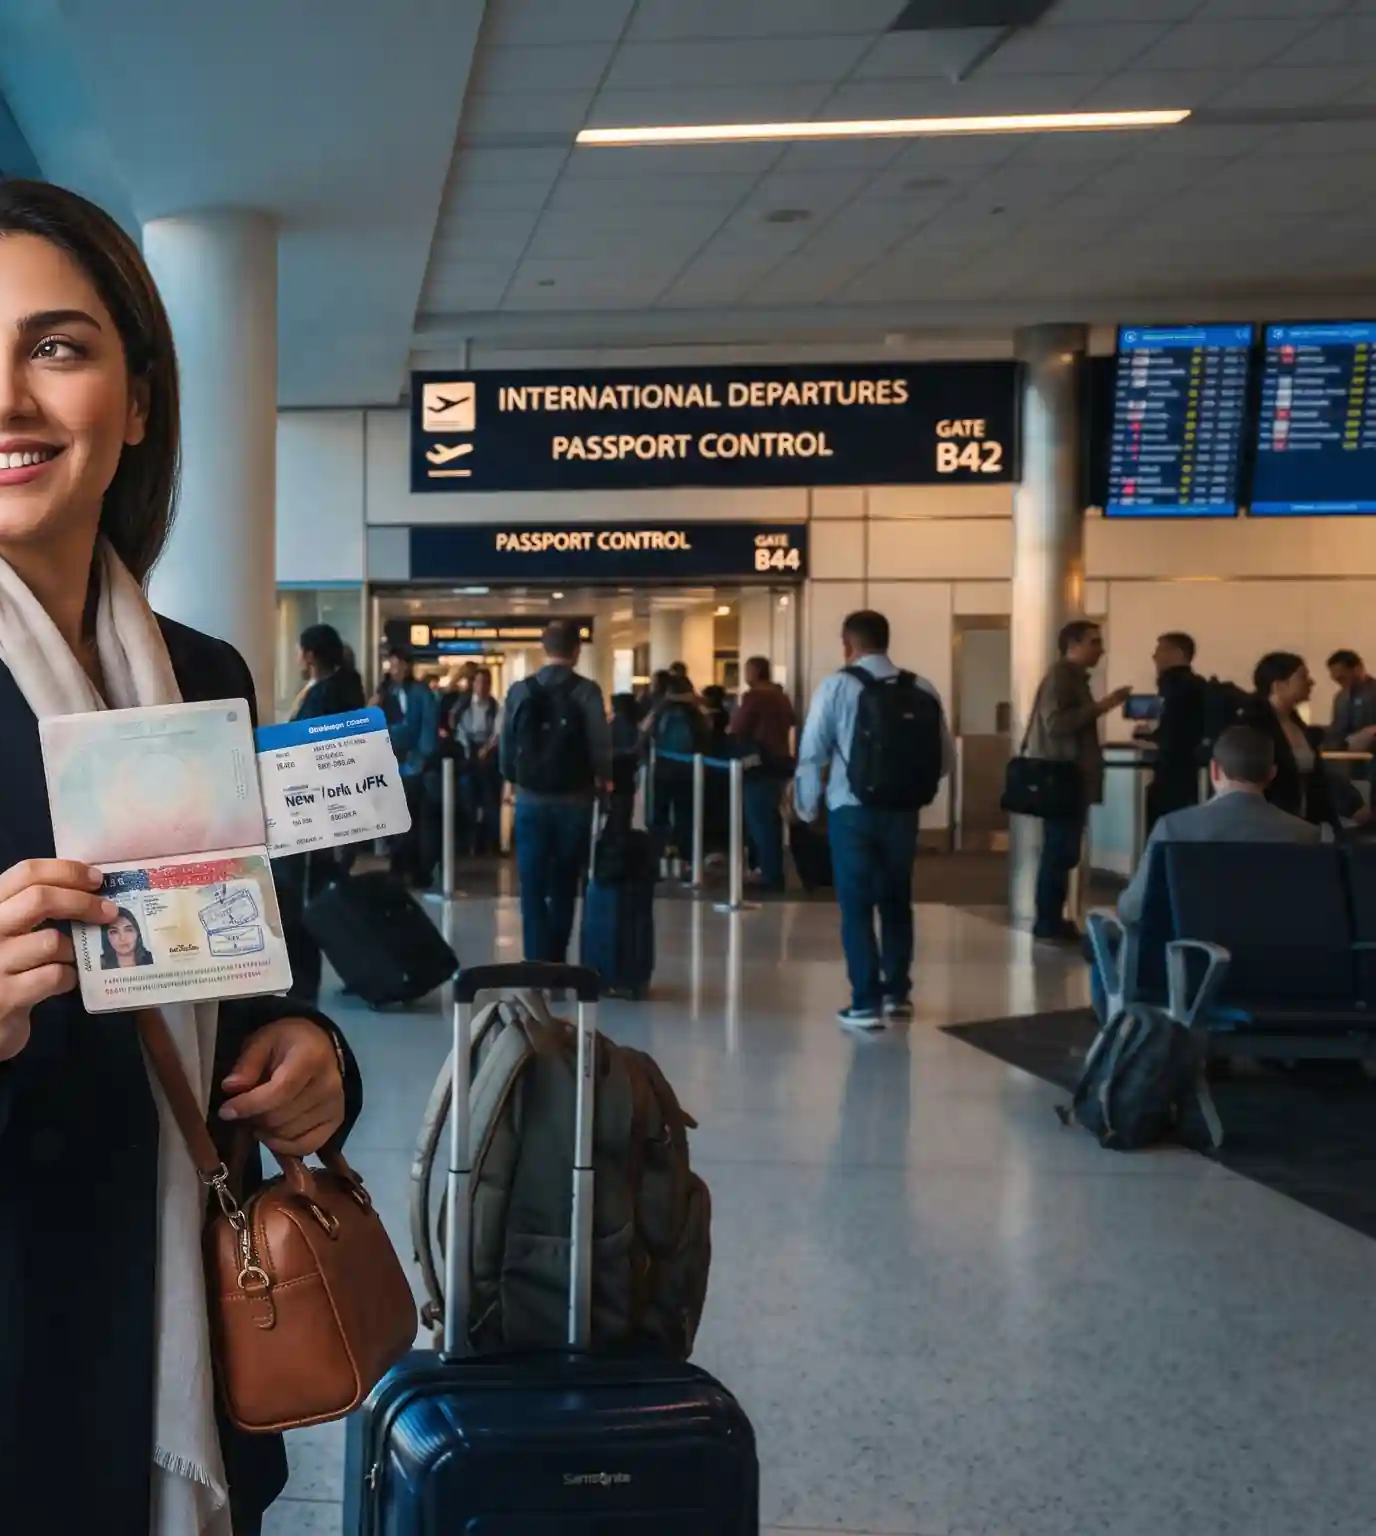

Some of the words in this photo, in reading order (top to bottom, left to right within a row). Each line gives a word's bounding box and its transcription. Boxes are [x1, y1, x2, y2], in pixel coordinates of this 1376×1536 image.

[498, 382, 722, 412] INTERNATIONAL
[728, 379, 909, 407] DEPARTURES
[935, 419, 985, 438] GATE
[552, 434, 692, 461] PASSPORT
[698, 431, 834, 459] CONTROL
[936, 440, 1003, 473] B42
[495, 531, 595, 552] PASSPORT
[596, 530, 691, 551] CONTROL
[754, 533, 790, 548] GATE
[754, 548, 801, 571] B44
[284, 793, 316, 808] New
